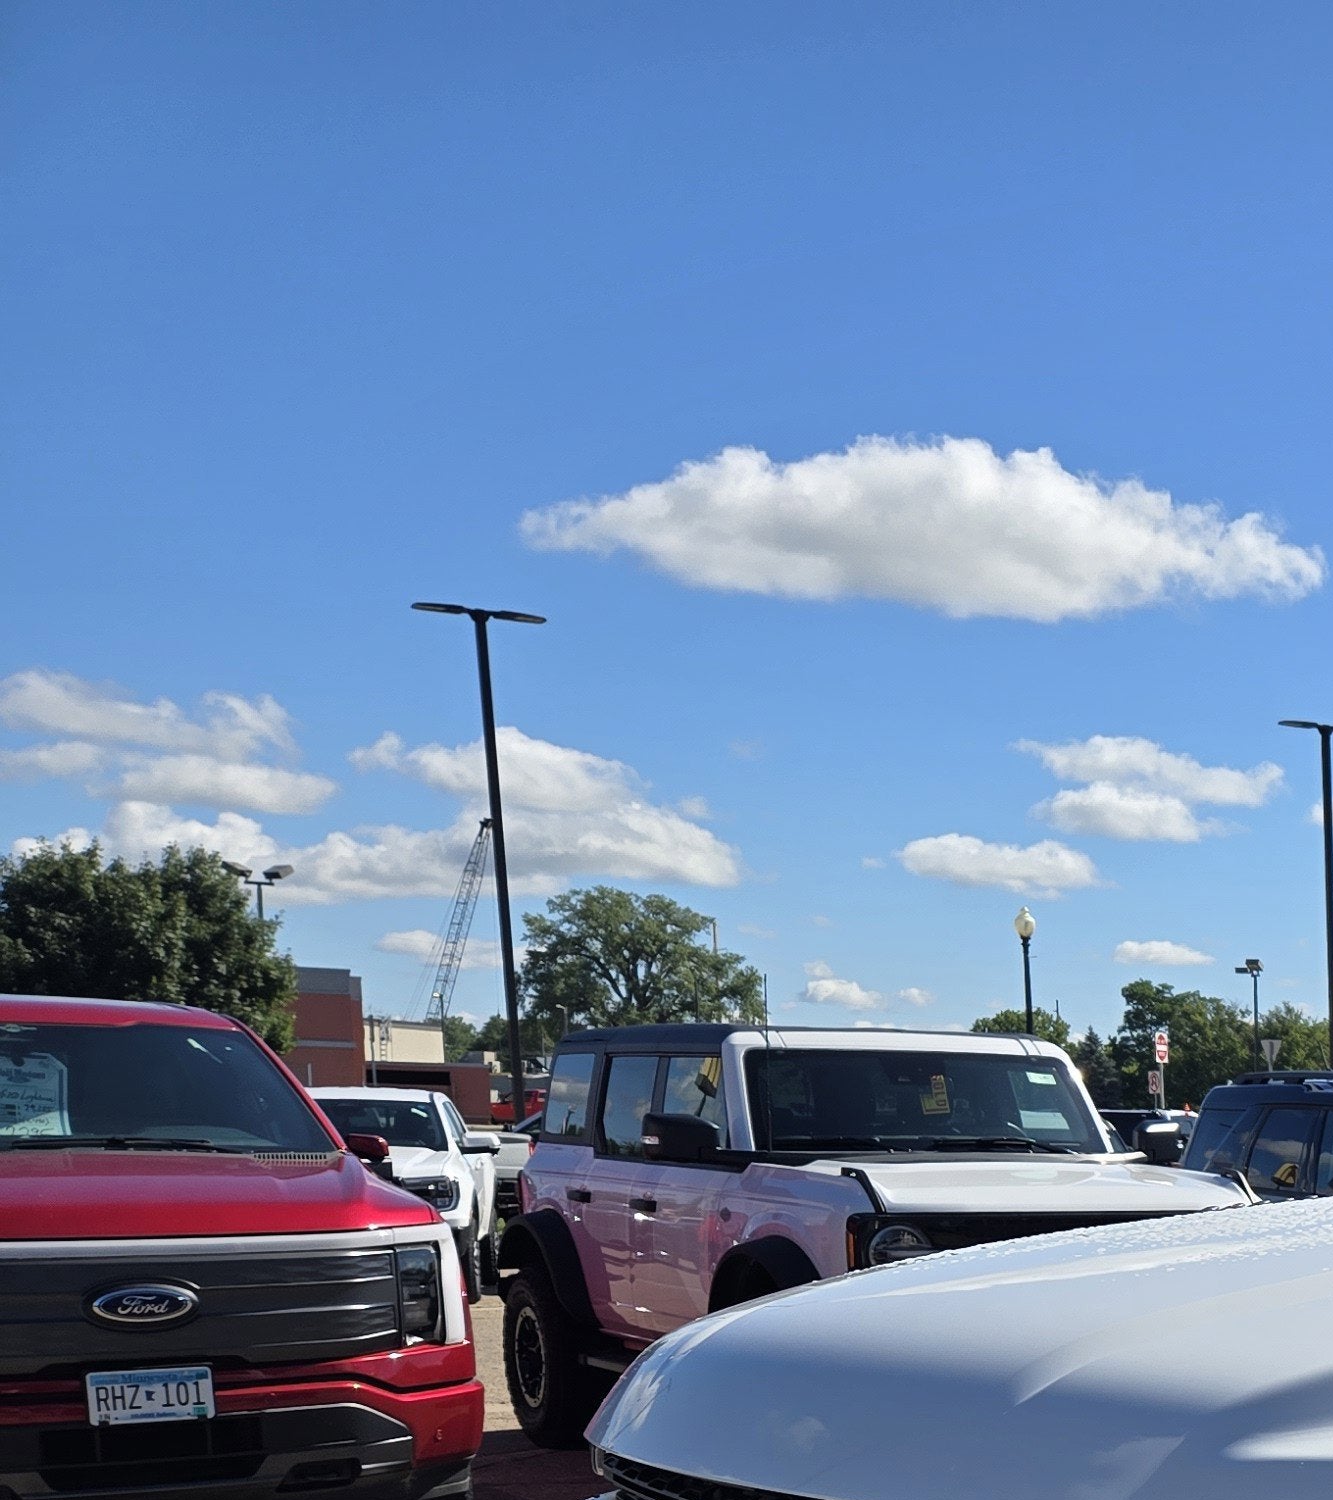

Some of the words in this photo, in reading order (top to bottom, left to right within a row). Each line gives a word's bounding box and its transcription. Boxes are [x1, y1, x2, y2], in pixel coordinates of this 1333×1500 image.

[117, 1295, 170, 1315] Ford
[95, 1384, 142, 1412] RHZ
[161, 1381, 206, 1408] 101
